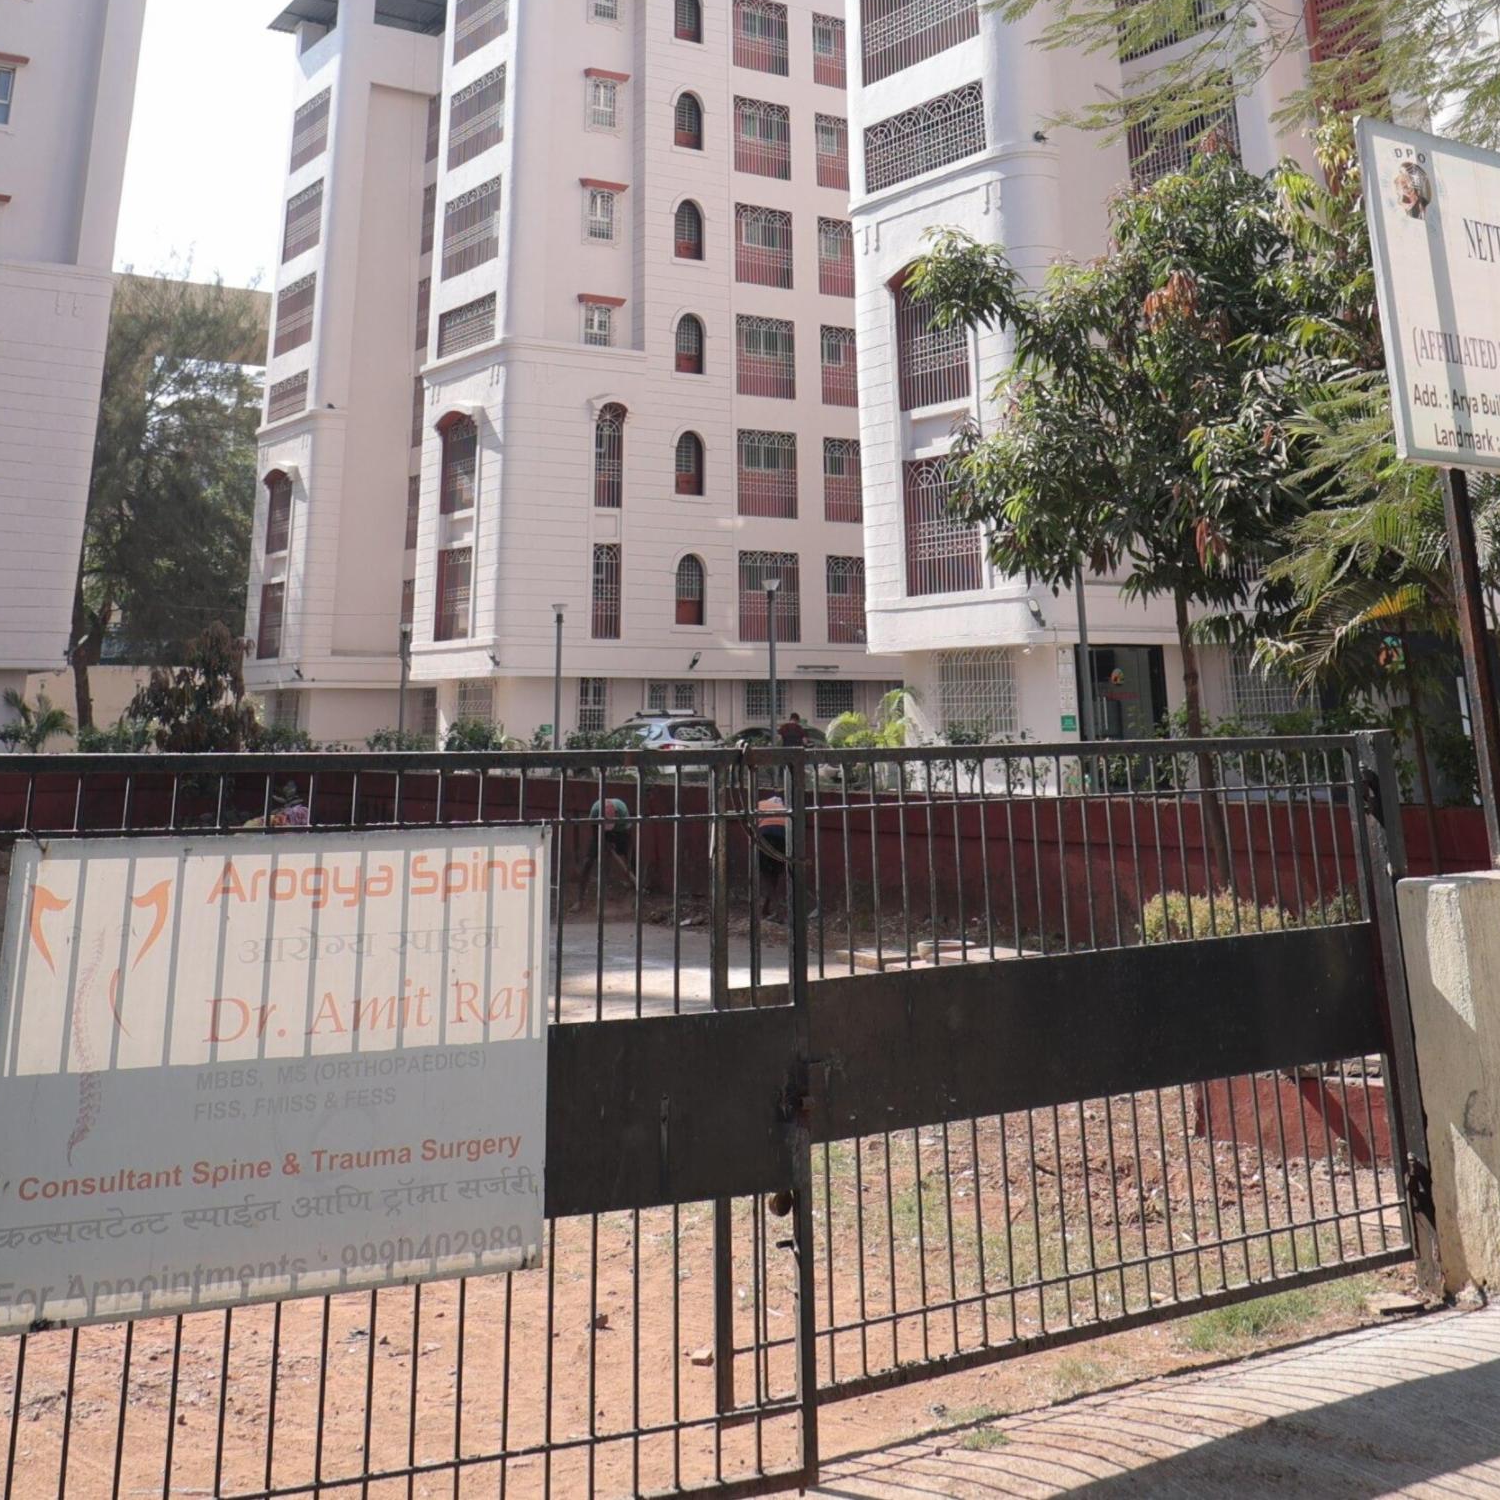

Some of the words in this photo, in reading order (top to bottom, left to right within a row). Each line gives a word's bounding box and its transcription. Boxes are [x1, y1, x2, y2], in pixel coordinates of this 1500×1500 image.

[1413, 327, 1498, 370] (AFFILIATED
[1413, 384, 1442, 409] Add.
[1452, 389, 1479, 418] Arya
[1434, 423, 1494, 451] Landmark
[206, 861, 393, 909] Arogya
[410, 851, 536, 902] Spine
[202, 997, 286, 1043] Dr.
[304, 978, 432, 1036] Amit
[448, 970, 531, 1038] Raj
[195, 1068, 265, 1092] MBBS,
[277, 1065, 308, 1085] MS
[314, 1050, 487, 1086] (ORTHOPAEDICS)
[192, 1100, 247, 1123] FISS,
[251, 1095, 318, 1118] FMISS
[323, 1091, 339, 1110] &
[344, 1086, 398, 1108] FESS
[18, 1164, 182, 1201] Consultant
[191, 1158, 273, 1189] Spine
[282, 1152, 300, 1176] &
[311, 1146, 412, 1173] Trauma
[420, 1134, 522, 1162] Surgery
[181, 1194, 282, 1230] स्पाईन
[291, 1185, 374, 1219] आणि
[65, 1253, 308, 1313] Appointments
